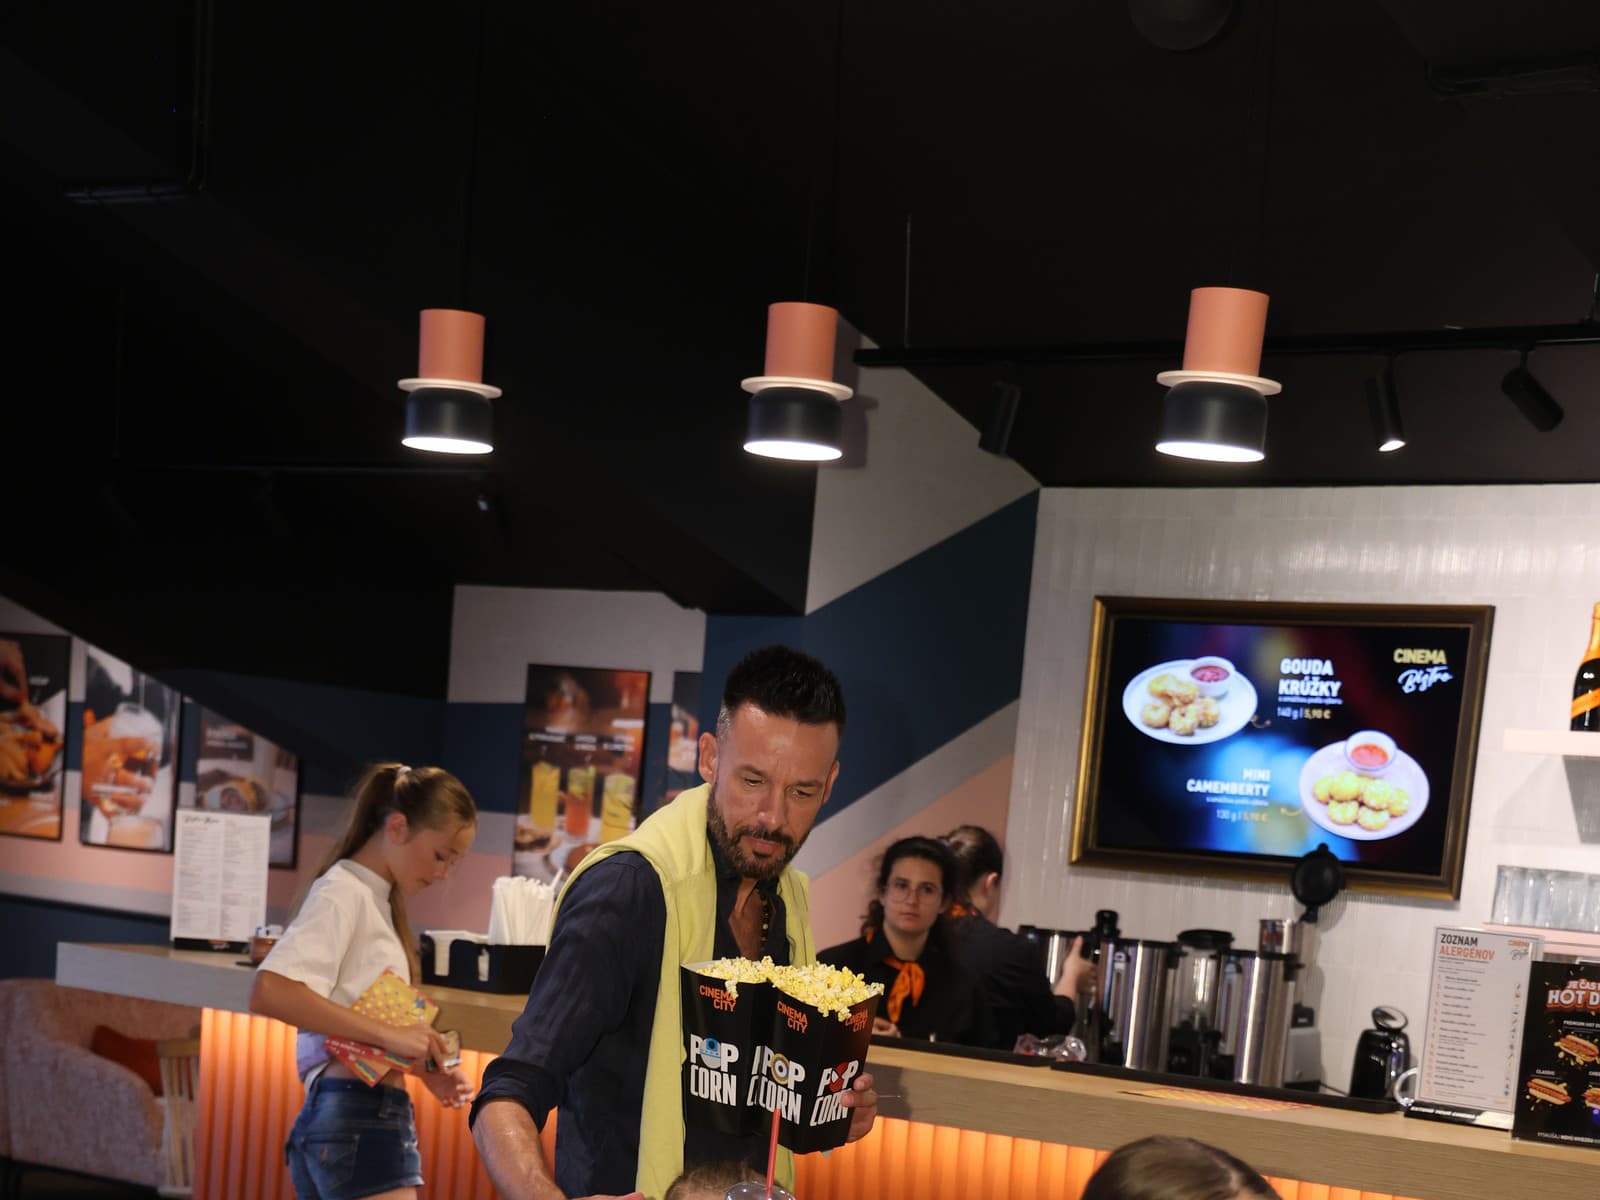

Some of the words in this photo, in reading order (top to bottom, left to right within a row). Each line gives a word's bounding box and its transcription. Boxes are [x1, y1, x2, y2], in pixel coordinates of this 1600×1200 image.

[1393, 648, 1448, 665] CINEMA
[1280, 657, 1334, 676] GOUDA
[1278, 675, 1342, 697] KRÚŽKY
[1243, 768, 1271, 782] MINI
[1186, 778, 1270, 797] CAMEMBERTY
[1440, 933, 1478, 946] ZOZNAM
[1439, 945, 1495, 961] ALERGÉNOV
[713, 999, 736, 1012] CITY
[1548, 989, 1586, 1005] HOT
[776, 1001, 808, 1024] CINEMA
[787, 1017, 808, 1034] CITY
[853, 1017, 868, 1032] CITY
[690, 1033, 739, 1073] POP
[761, 1045, 806, 1090] POP
[690, 1063, 737, 1107] CORN
[816, 1060, 859, 1097] POP
[758, 1076, 802, 1125] CORN
